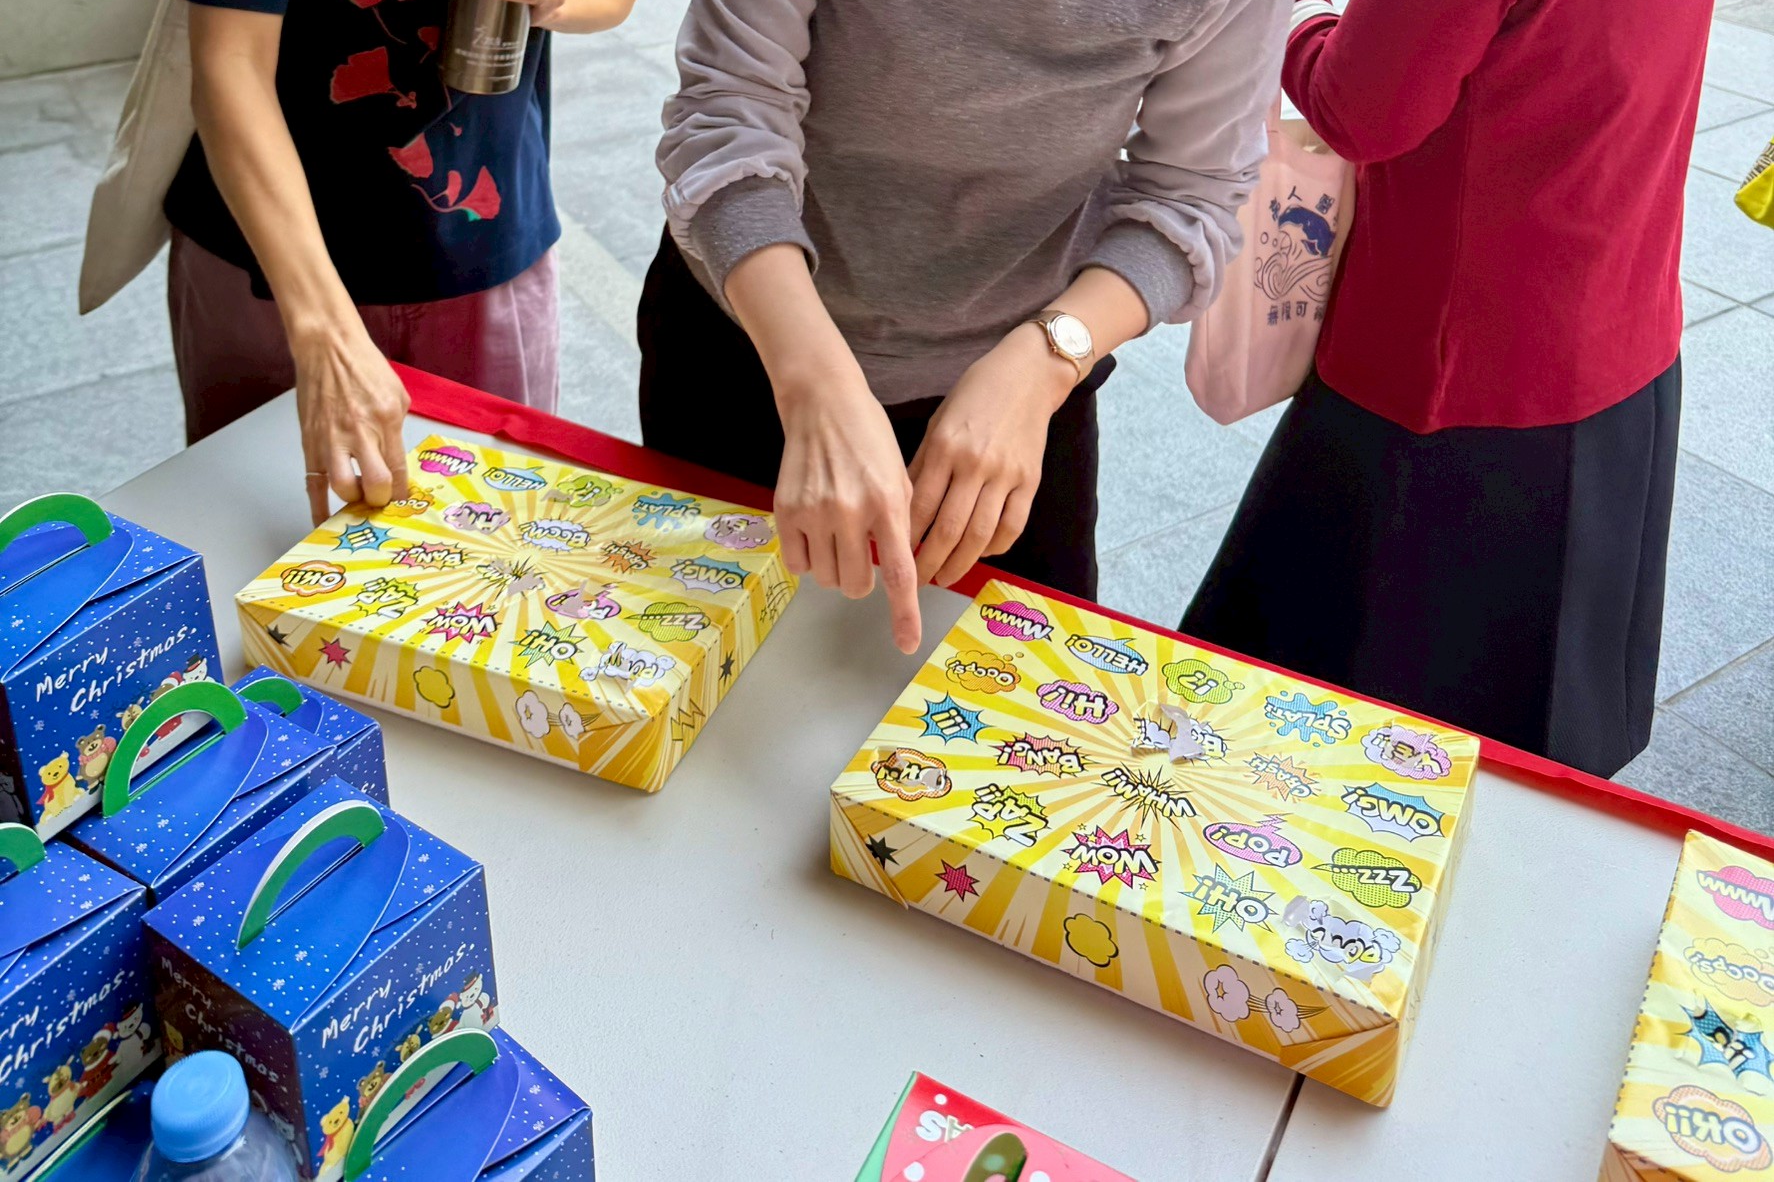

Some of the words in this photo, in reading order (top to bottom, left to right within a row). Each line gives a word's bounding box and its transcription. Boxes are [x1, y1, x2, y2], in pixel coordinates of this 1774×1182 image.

[482, 467, 547, 491] HELLO!
[391, 544, 464, 567] BANG!
[671, 559, 744, 589] OMG!
[283, 569, 344, 588] OK!!
[519, 629, 577, 661] OH!
[1064, 634, 1150, 677] HELLO!
[36, 646, 108, 702] Merry
[1042, 685, 1108, 719] Hi!
[997, 740, 1084, 774] BANG!
[1249, 756, 1312, 798] CRASH
[1341, 786, 1441, 838] OMG!
[1210, 827, 1291, 868] POP!
[1198, 875, 1270, 925] OH!
[161, 956, 213, 1009] Merry
[322, 978, 392, 1049] Merry
[1663, 1102, 1762, 1155] OK!!
